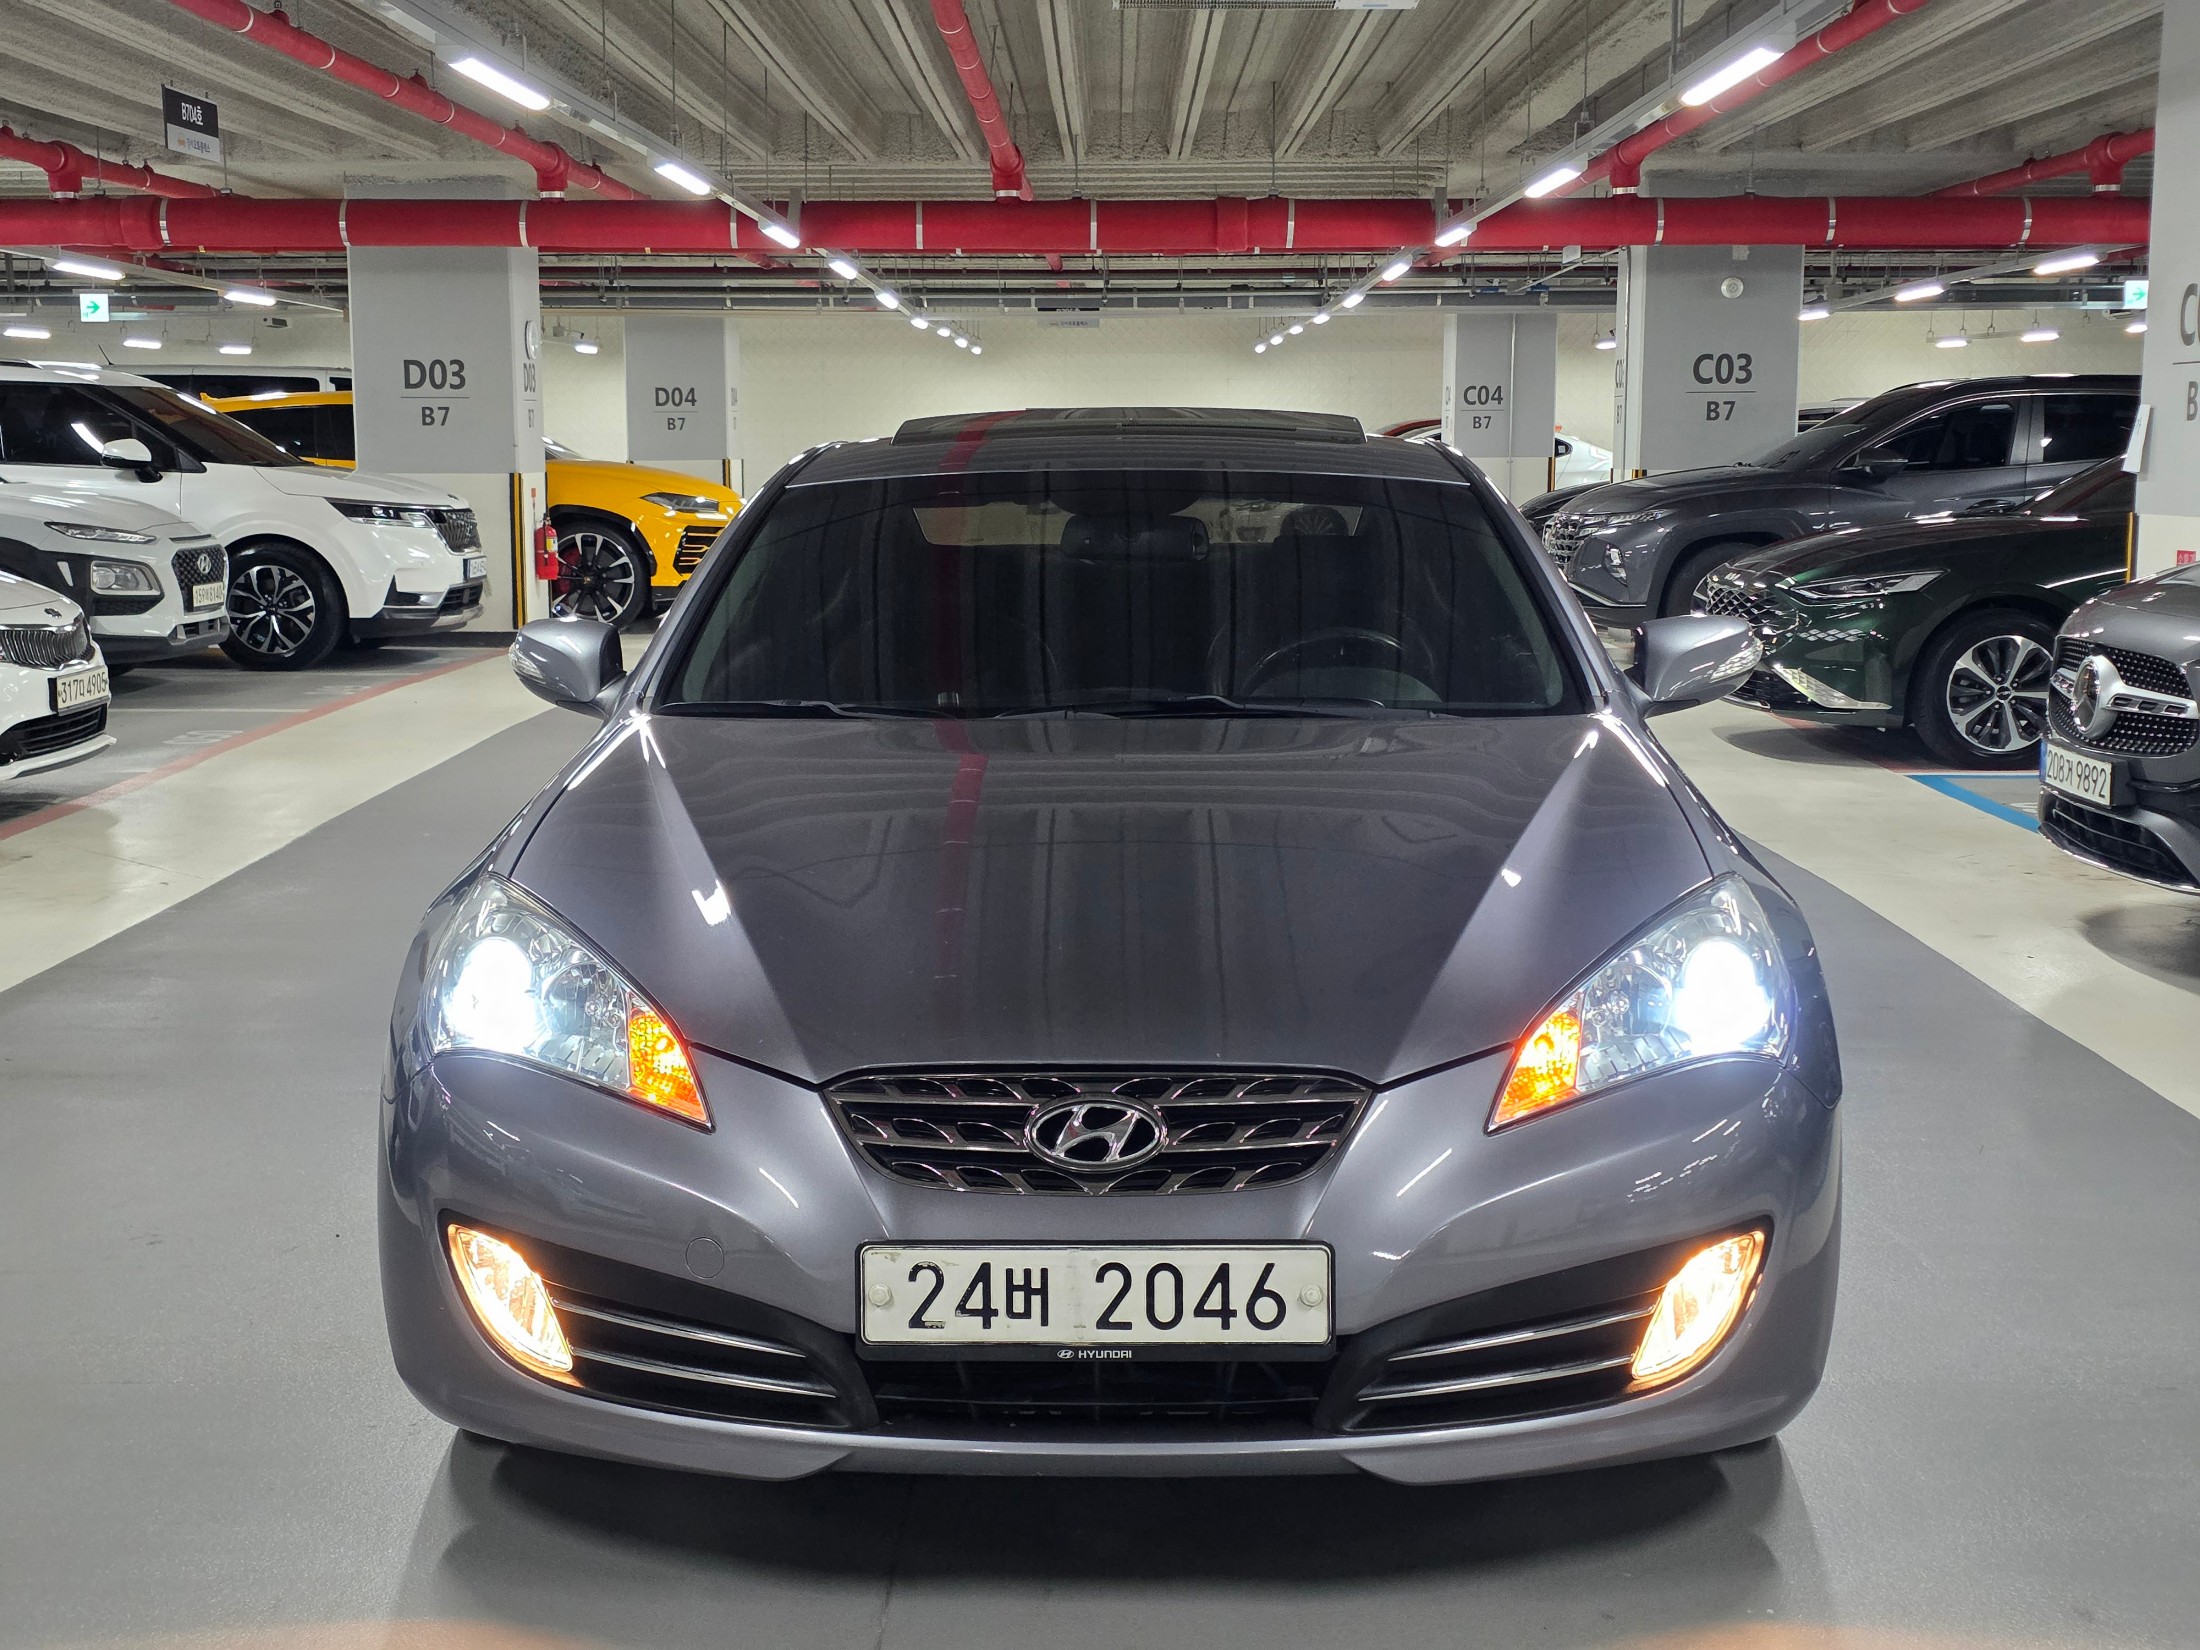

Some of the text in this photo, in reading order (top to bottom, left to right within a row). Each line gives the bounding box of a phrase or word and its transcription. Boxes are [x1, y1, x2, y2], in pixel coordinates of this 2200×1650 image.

[2180, 283, 2200, 346] C
[403, 359, 466, 390] D03
[1693, 353, 1753, 385] C03
[655, 386, 697, 407] D04
[1463, 385, 1504, 406] C04
[421, 406, 450, 426] B7
[1706, 401, 1736, 421] B7
[667, 417, 686, 431] B7
[1473, 416, 1492, 429] B7
[87, 671, 107, 697] 4905
[2046, 749, 2107, 799] 208거 9892
[908, 1261, 1287, 1331] 24버 2046
[1078, 1350, 1132, 1359] HYUNDAI
